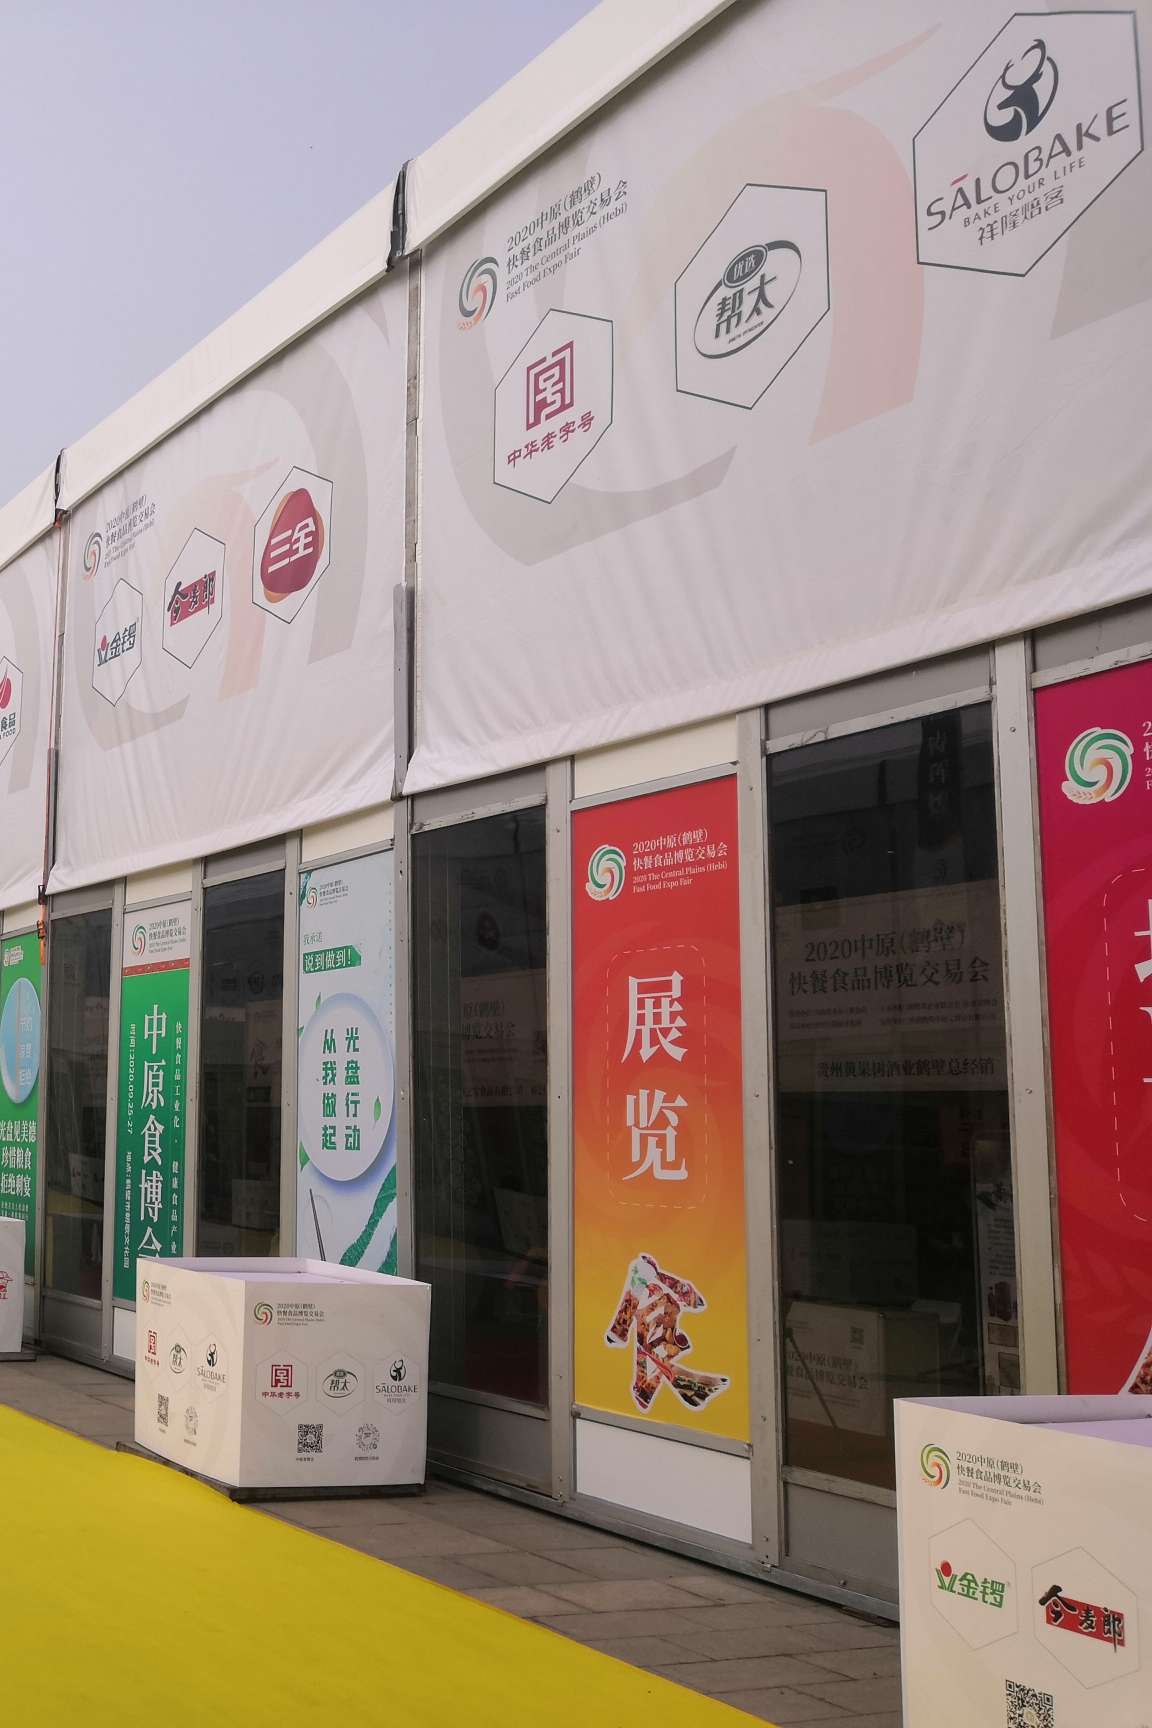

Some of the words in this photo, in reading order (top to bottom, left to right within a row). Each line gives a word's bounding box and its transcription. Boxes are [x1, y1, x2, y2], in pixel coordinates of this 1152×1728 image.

[963, 203, 1001, 228] BAKE
[1008, 177, 1046, 206] YOUR
[1054, 156, 1087, 181] LIFE
[506, 179, 628, 275] 快餐食品博览交易会
[525, 261, 541, 278] The
[540, 239, 571, 266] Central
[571, 224, 598, 246] Plains
[522, 272, 542, 292] Food
[543, 260, 563, 280] Expo
[564, 246, 582, 267] Fair
[715, 273, 776, 340] 帮太
[506, 411, 596, 469] 中华老字号
[267, 516, 317, 574] 三全
[632, 841, 729, 872] 快餐食品博览交易会
[646, 880, 662, 892] Food
[663, 879, 680, 892] Expo
[680, 877, 694, 888] Fair
[648, 871, 661, 882] The
[661, 866, 685, 879] Central
[685, 863, 706, 876] Plains
[321, 1027, 337, 1151] 从我做起
[344, 1026, 361, 1151] 光盘行动
[620, 969, 689, 1182] 展览
[956, 1463, 1042, 1495] 快餐食品博览交易会
[957, 1571, 1006, 1609] 金锣
[1038, 1584, 1126, 1654] 今麦郎
